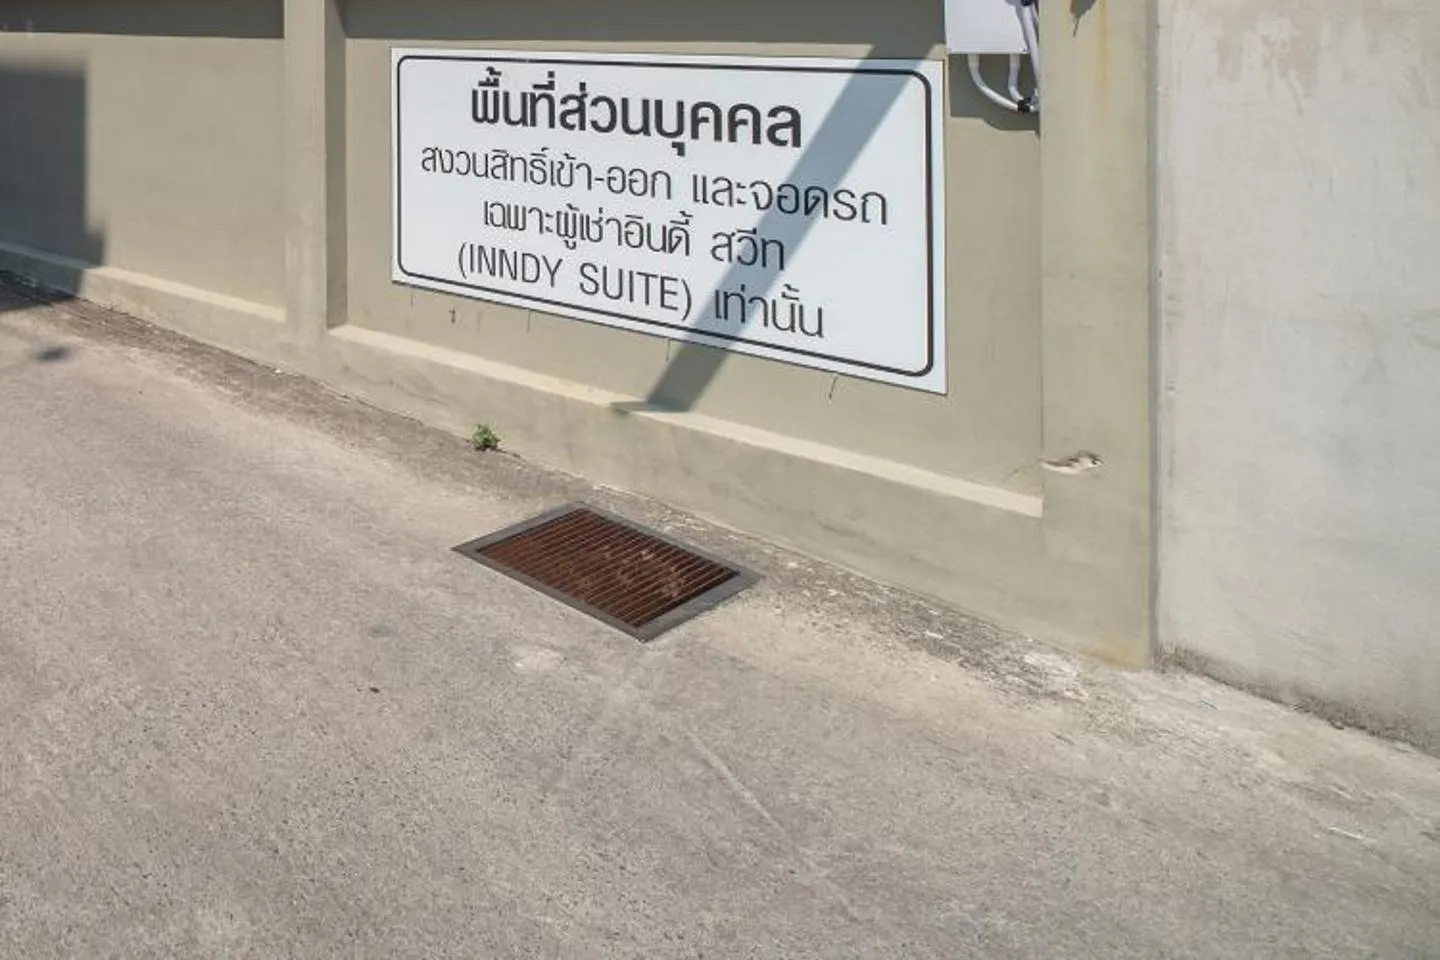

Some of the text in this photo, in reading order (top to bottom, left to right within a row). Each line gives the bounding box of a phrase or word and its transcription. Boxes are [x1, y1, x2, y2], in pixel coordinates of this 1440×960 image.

[471, 67, 803, 156] พื้นที่ส่วนบุคคล
[421, 146, 888, 226] สงวนสิทธิ์เข้า-ออก และจอดรถ
[484, 200, 785, 271] เฉพาะผู้เช่าอินดี้ สวีท
[458, 242, 825, 339] (INNDY SUITE) เท่านั้น
